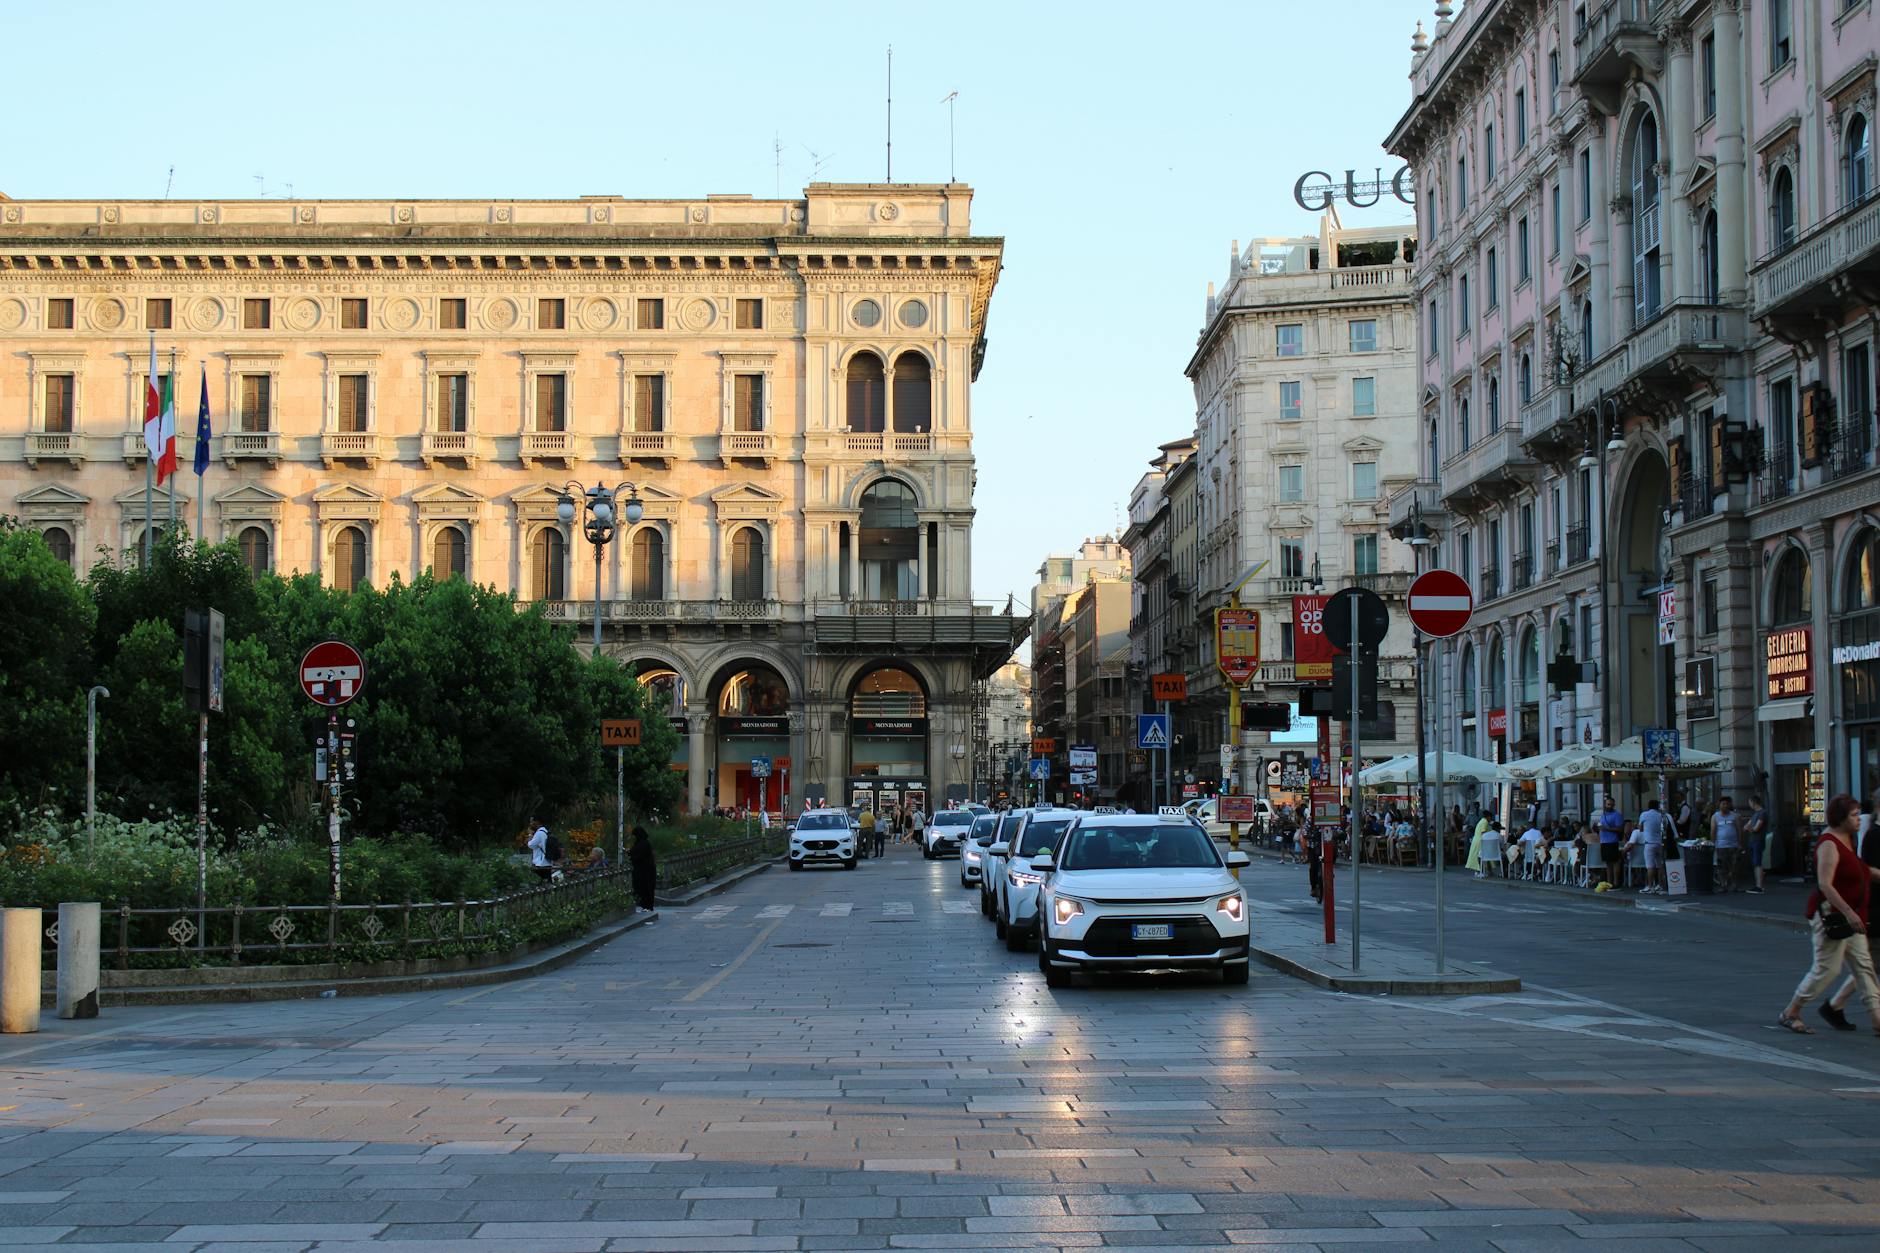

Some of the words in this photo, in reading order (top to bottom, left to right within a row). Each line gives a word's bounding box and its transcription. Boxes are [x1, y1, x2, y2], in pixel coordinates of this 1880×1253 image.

[1294, 165, 1415, 211] GUC
[1300, 599, 1326, 611] MIL
[1660, 592, 1675, 616] KF
[1300, 611, 1323, 623] OP
[1300, 622, 1323, 634] TO
[1768, 630, 1806, 657] GELATERIA
[1768, 653, 1807, 675] AMBROSIANA
[1155, 681, 1183, 692] TAXI
[1769, 680, 1779, 694] BAR
[1784, 676, 1806, 692] BISTROT
[605, 727, 637, 738] TAXI
[1034, 742, 1054, 750] TAXI
[1162, 806, 1184, 815] TAXI
